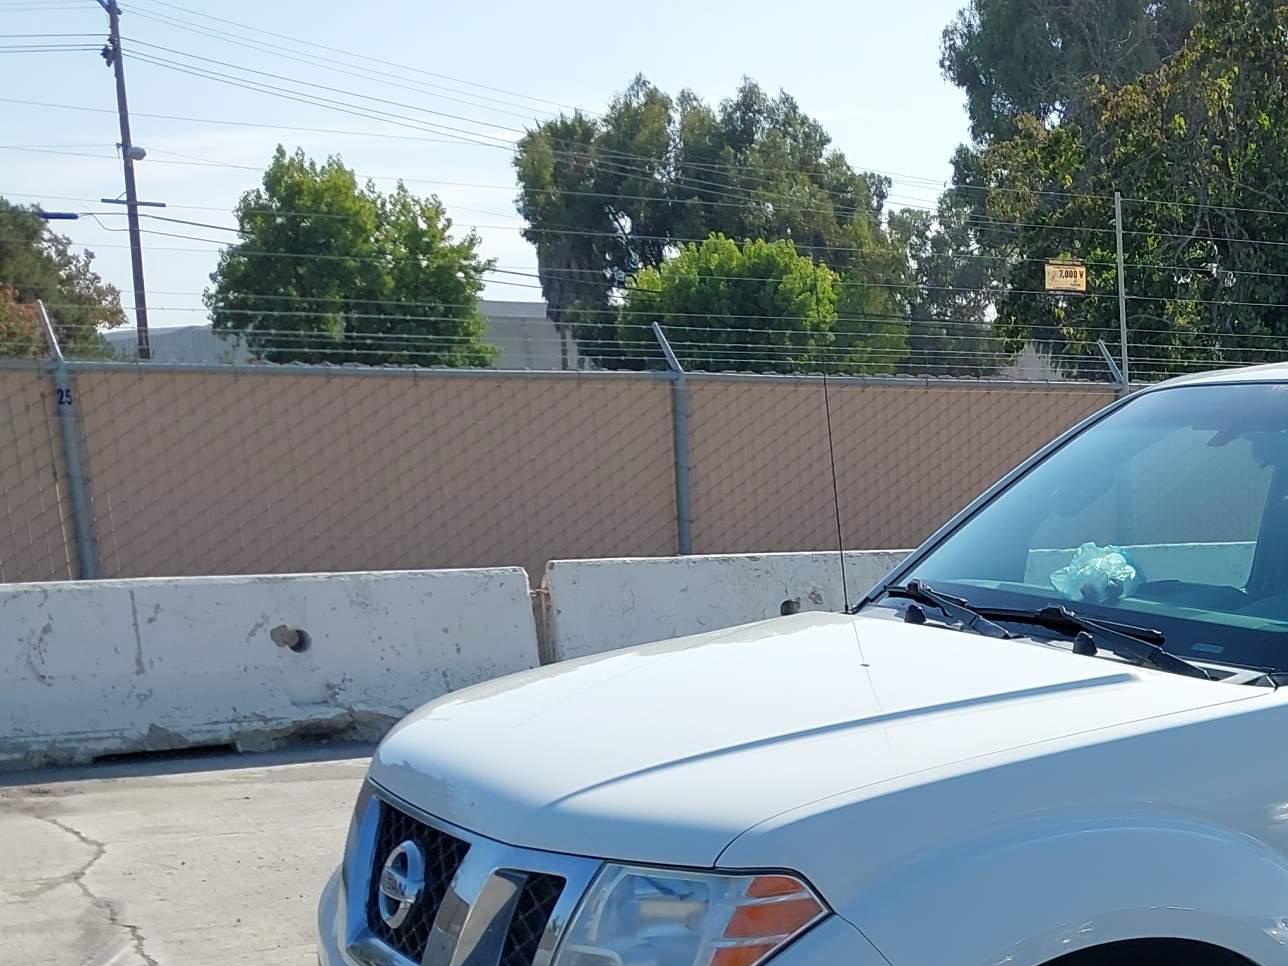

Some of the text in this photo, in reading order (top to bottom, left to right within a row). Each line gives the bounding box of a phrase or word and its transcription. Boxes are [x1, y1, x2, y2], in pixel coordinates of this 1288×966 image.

[1059, 269, 1085, 279] 7,000 V
[57, 388, 73, 405] 25
